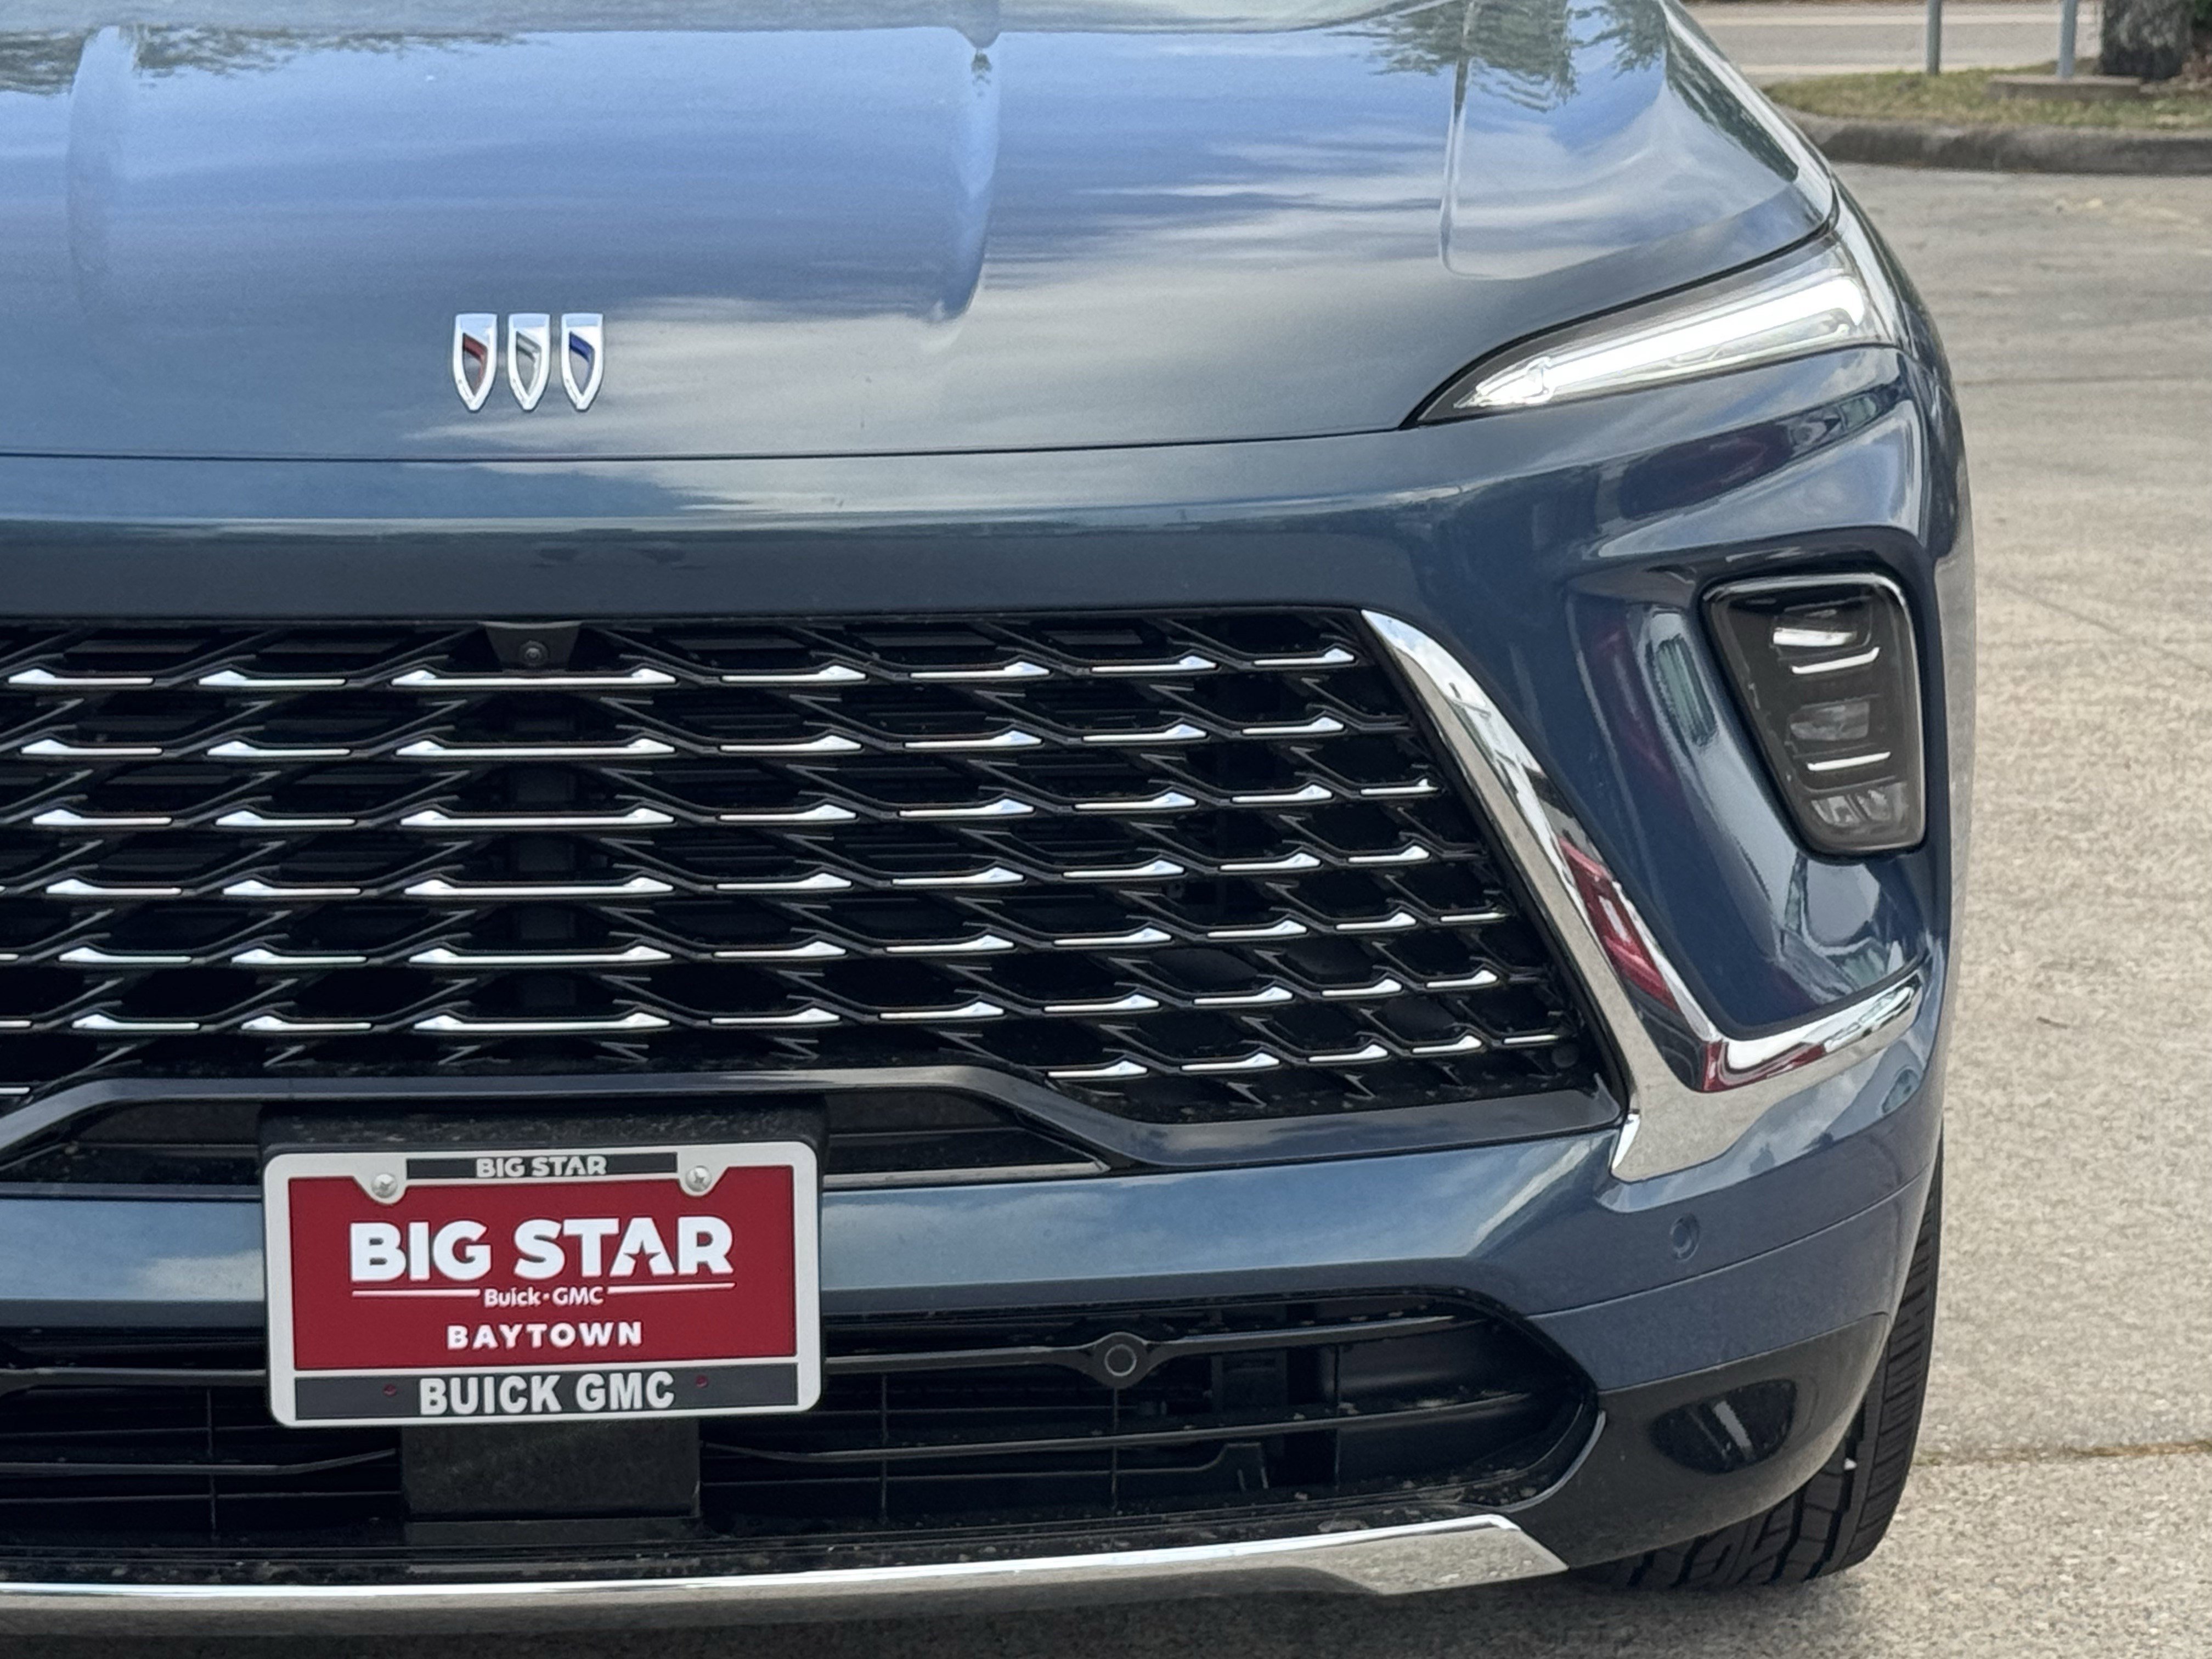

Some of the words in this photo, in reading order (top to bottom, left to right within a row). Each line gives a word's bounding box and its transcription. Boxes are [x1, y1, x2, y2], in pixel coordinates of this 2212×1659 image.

[476, 1157, 527, 1178] BIG
[531, 1155, 607, 1177] STAR
[349, 1220, 492, 1282] BIG
[514, 1215, 734, 1279] STAR
[446, 1321, 642, 1350] BAYTOWN
[419, 1374, 563, 1416] BUICK
[575, 1371, 675, 1412] GMC
